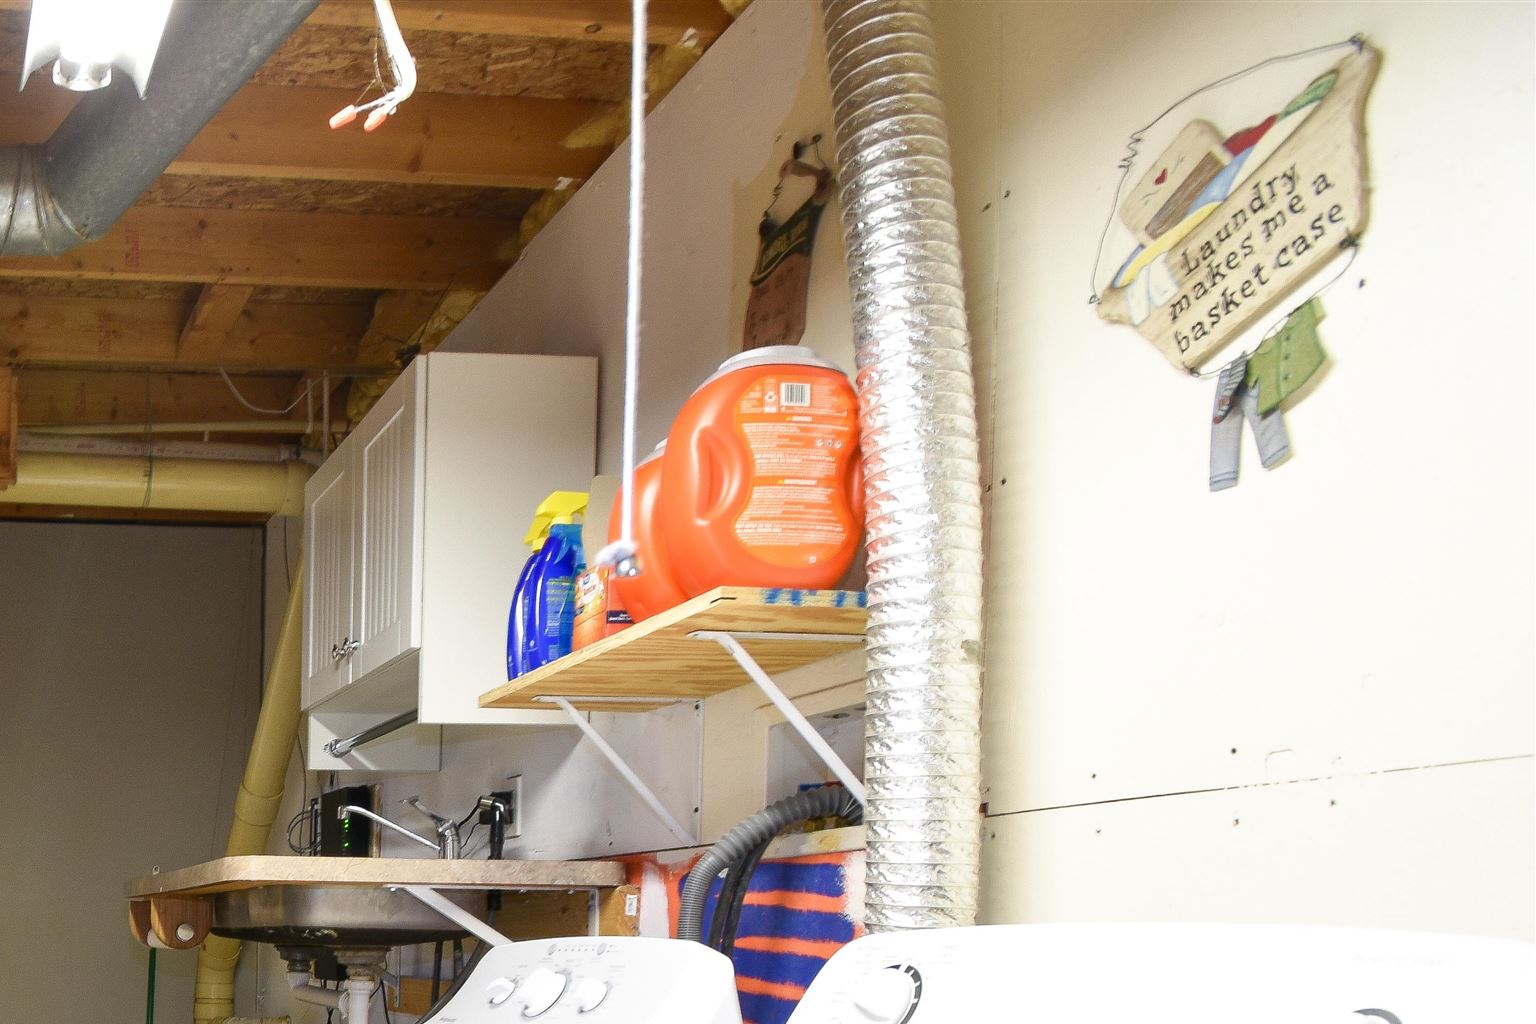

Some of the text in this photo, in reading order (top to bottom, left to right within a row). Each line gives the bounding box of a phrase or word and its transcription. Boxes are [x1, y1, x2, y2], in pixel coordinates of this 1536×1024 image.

[1169, 173, 1334, 322] makes me a
[1175, 203, 1344, 353] basket case
[1182, 162, 1299, 277] Laundry
